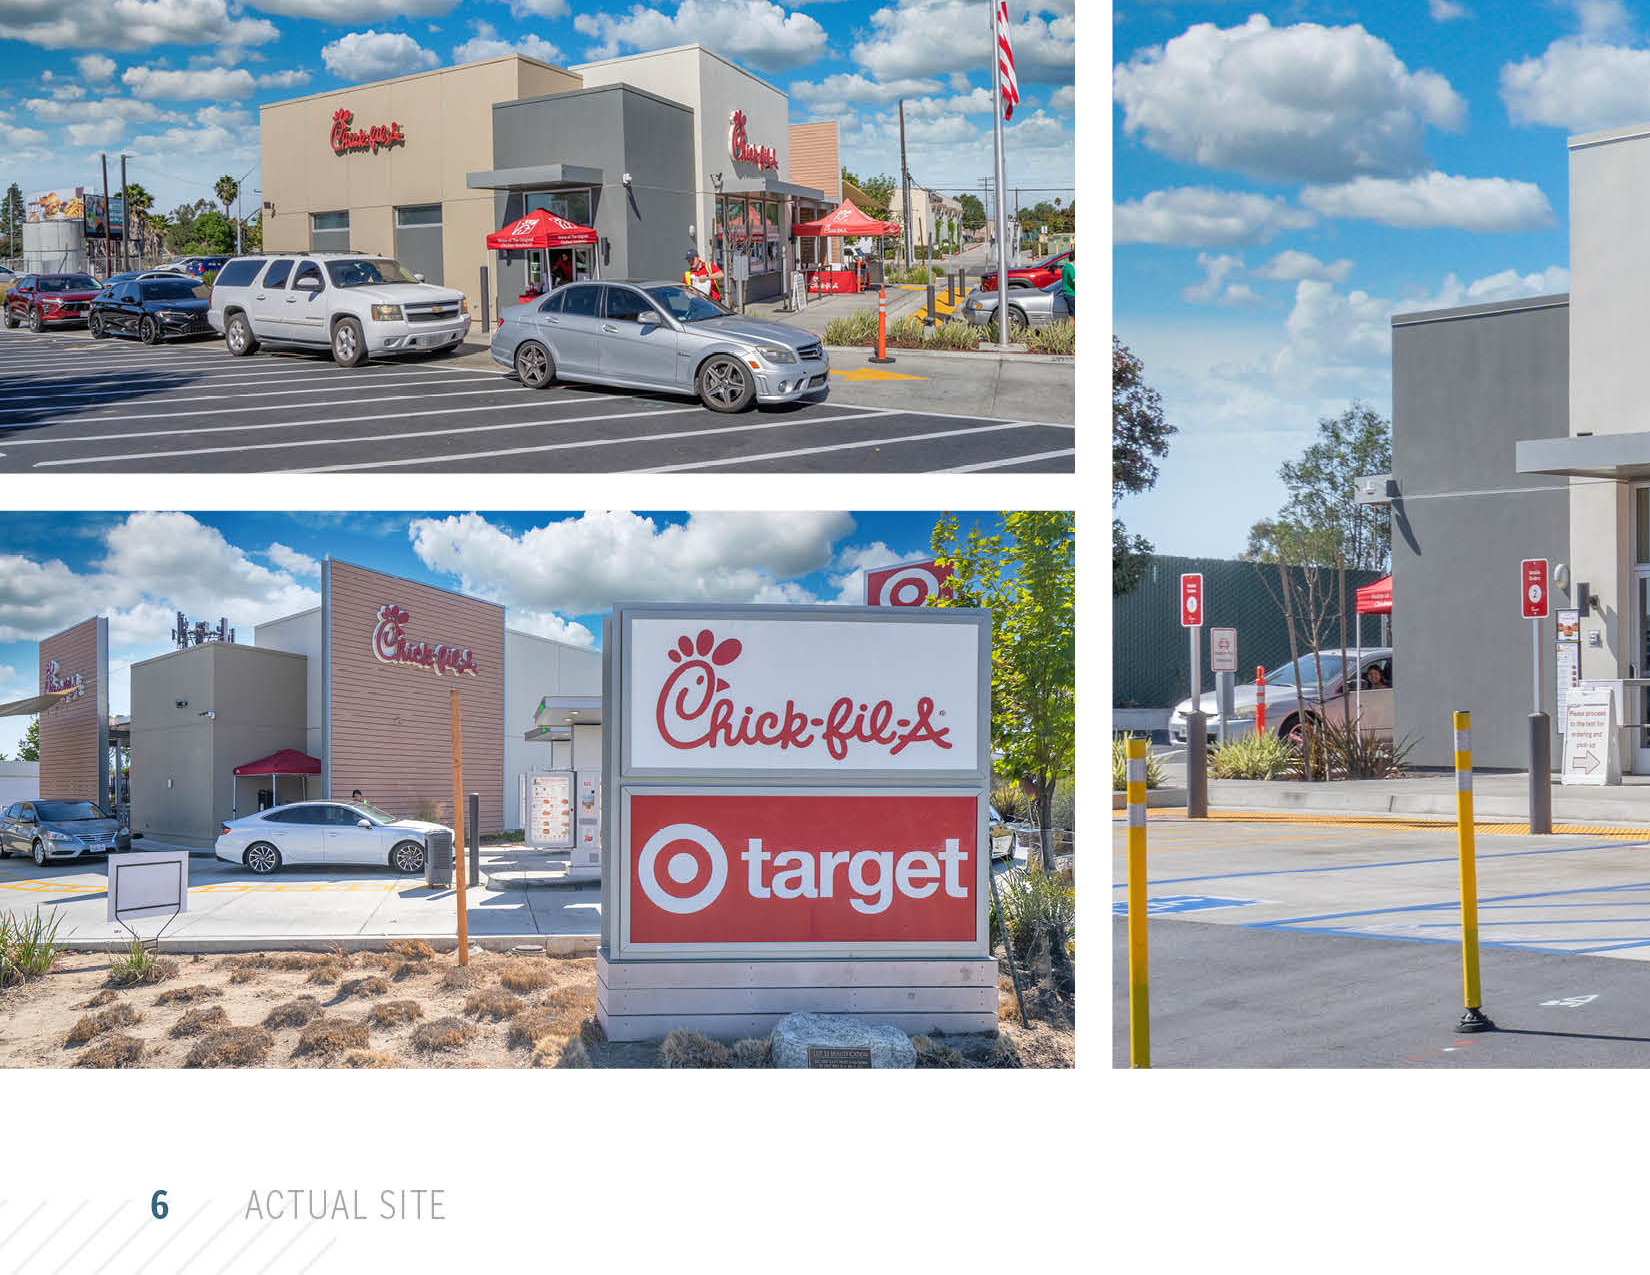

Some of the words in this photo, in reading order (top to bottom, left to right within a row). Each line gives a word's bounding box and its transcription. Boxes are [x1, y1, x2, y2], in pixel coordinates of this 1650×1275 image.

[330, 108, 401, 149] Chick-fil-A
[377, 605, 478, 674] Chick-fil-A
[656, 629, 952, 760] Chick-fil-A
[741, 838, 969, 914] target
